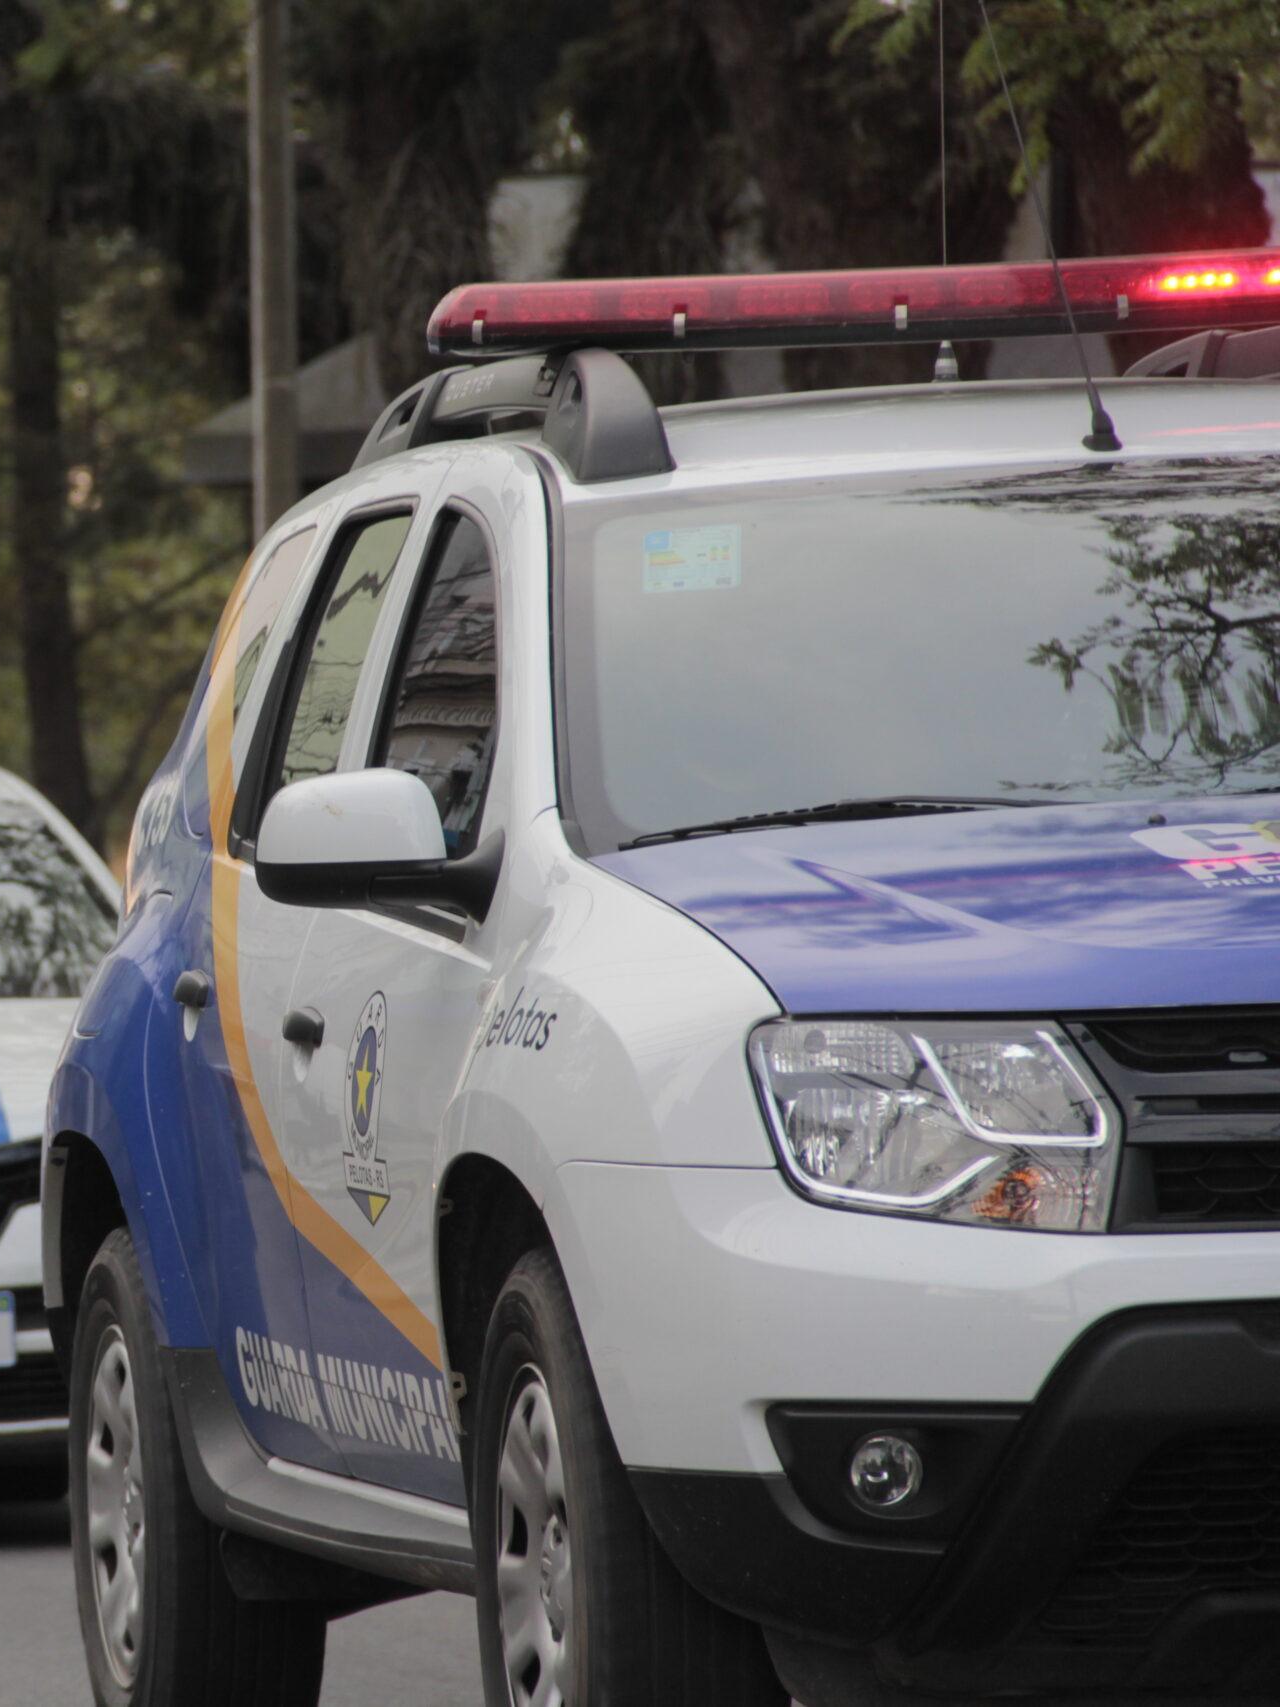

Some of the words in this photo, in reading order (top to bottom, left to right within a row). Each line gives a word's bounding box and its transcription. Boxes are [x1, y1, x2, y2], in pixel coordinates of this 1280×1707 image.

[1179, 853, 1280, 881] PE
[1203, 874, 1280, 890] PREV
[486, 985, 557, 1051] elotas
[235, 1325, 328, 1432] GUARDA
[317, 1353, 462, 1463] MUNICIPAL
